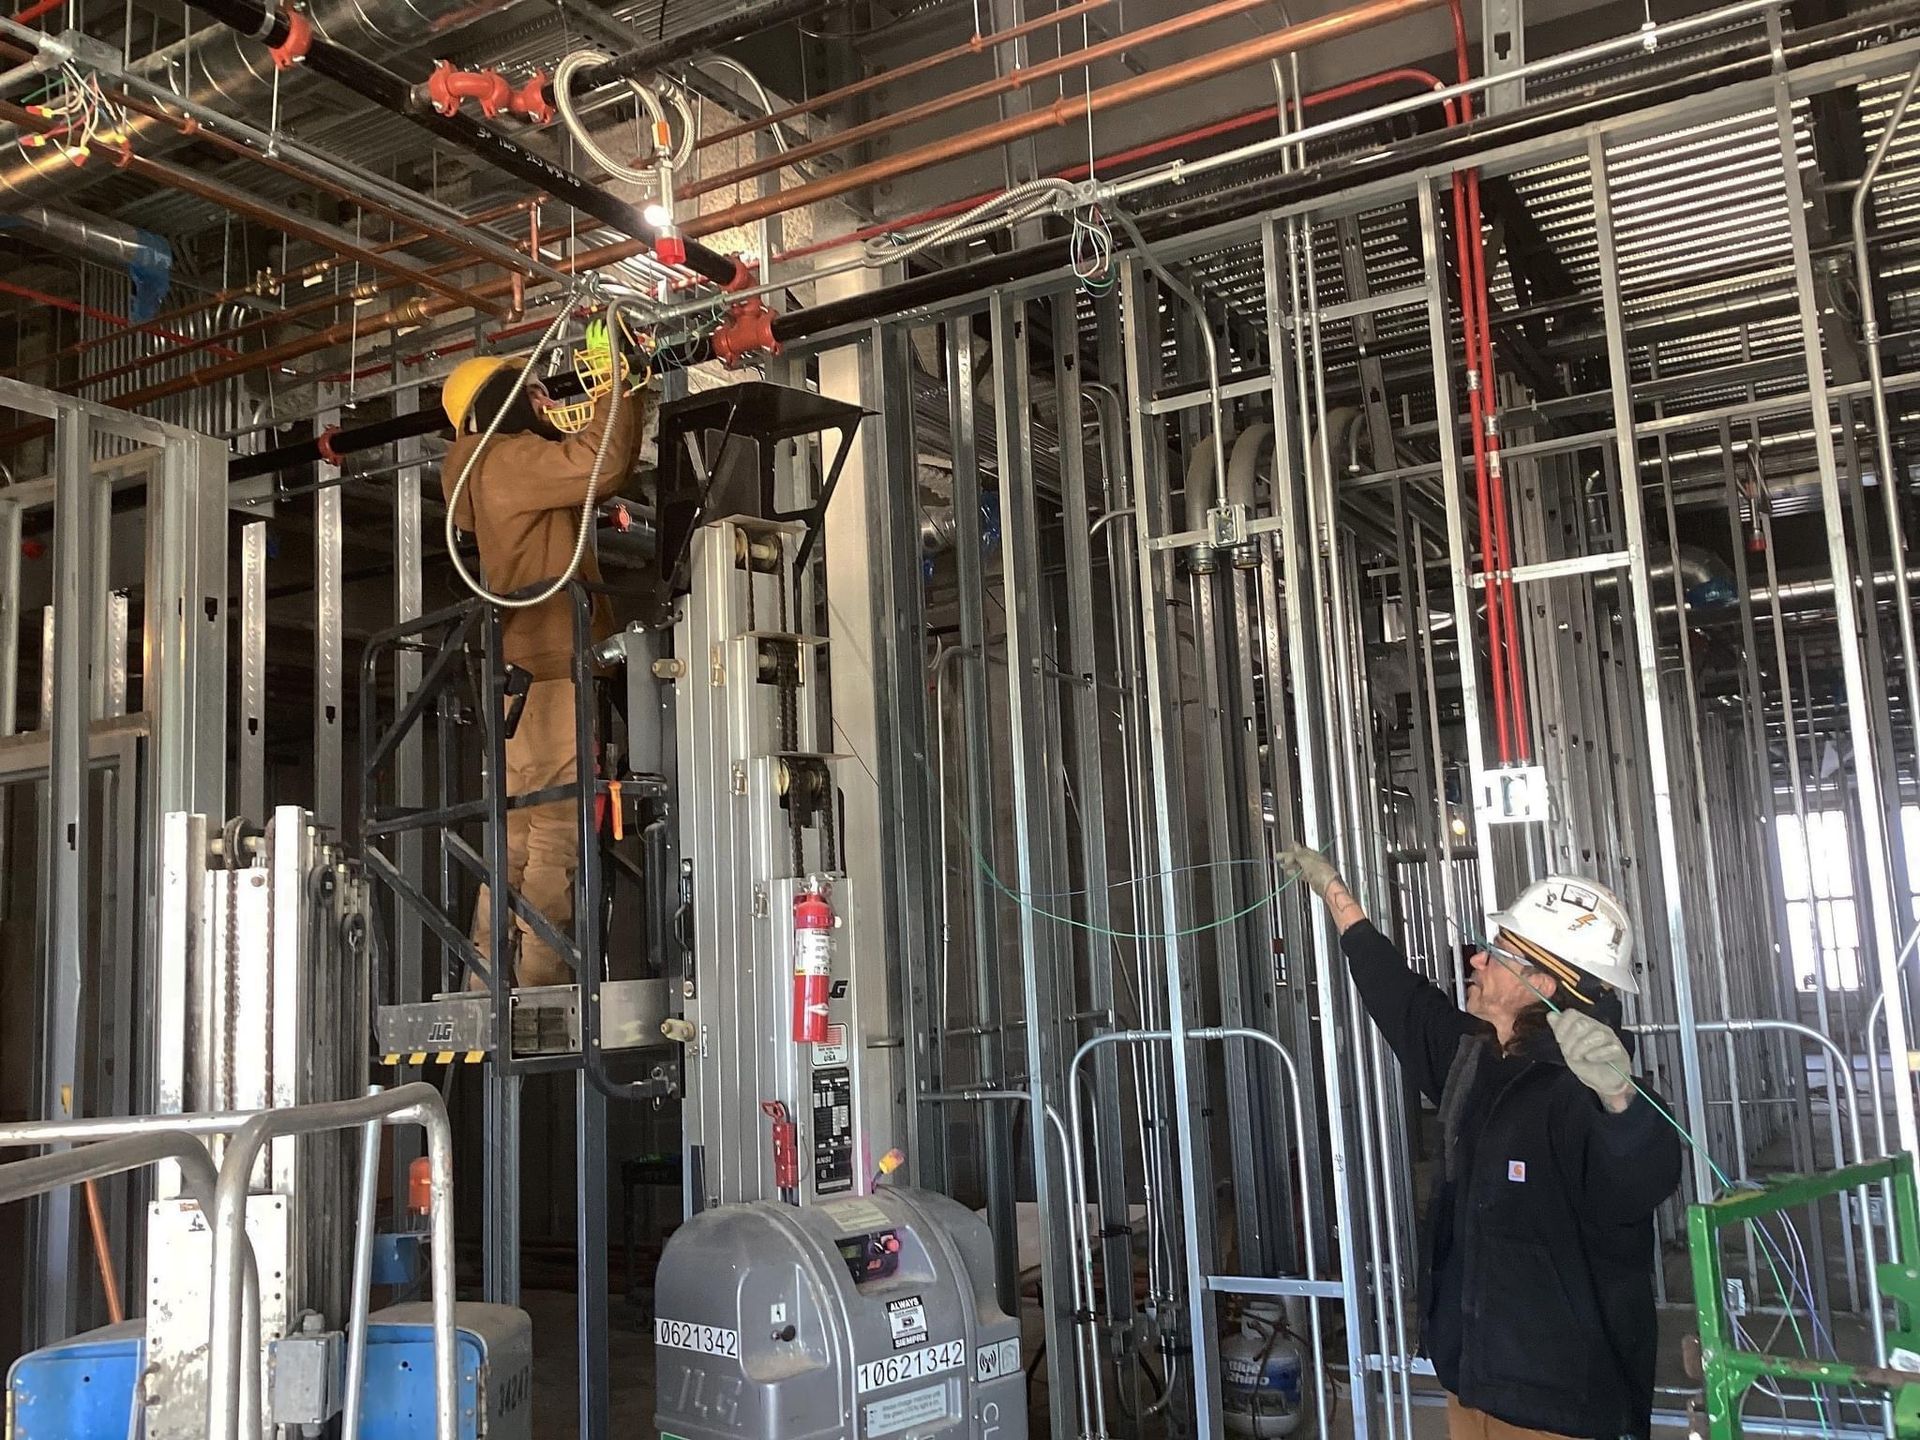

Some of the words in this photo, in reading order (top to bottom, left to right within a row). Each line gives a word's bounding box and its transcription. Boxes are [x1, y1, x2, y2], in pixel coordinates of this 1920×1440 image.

[428, 1023, 453, 1042] JLG
[815, 1155, 832, 1165] ANSI
[890, 1296, 920, 1312] ALWAYS
[894, 1332, 926, 1349] SIEMPRE
[860, 1341, 963, 1390] 10621342
